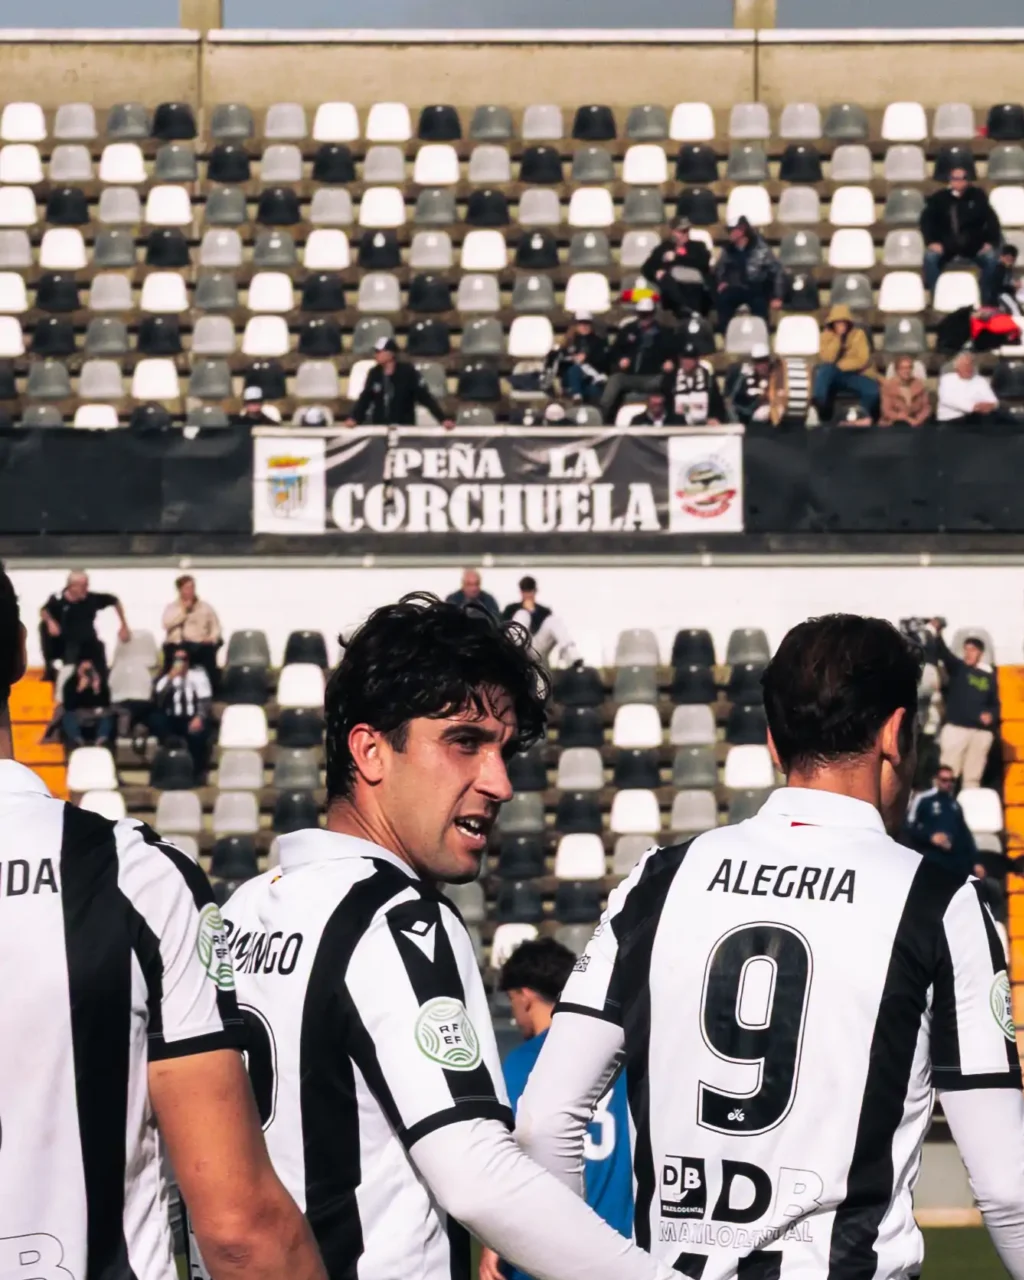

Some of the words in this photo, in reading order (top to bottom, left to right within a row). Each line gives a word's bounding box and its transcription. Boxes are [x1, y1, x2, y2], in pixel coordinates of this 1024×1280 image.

[393, 443, 505, 479] PEÑA
[548, 447, 602, 479] LA
[333, 482, 660, 532] CORCHUELA
[0, 857, 59, 897] DA
[707, 858, 856, 904] ALEGRIA
[696, 920, 814, 1137] 9
